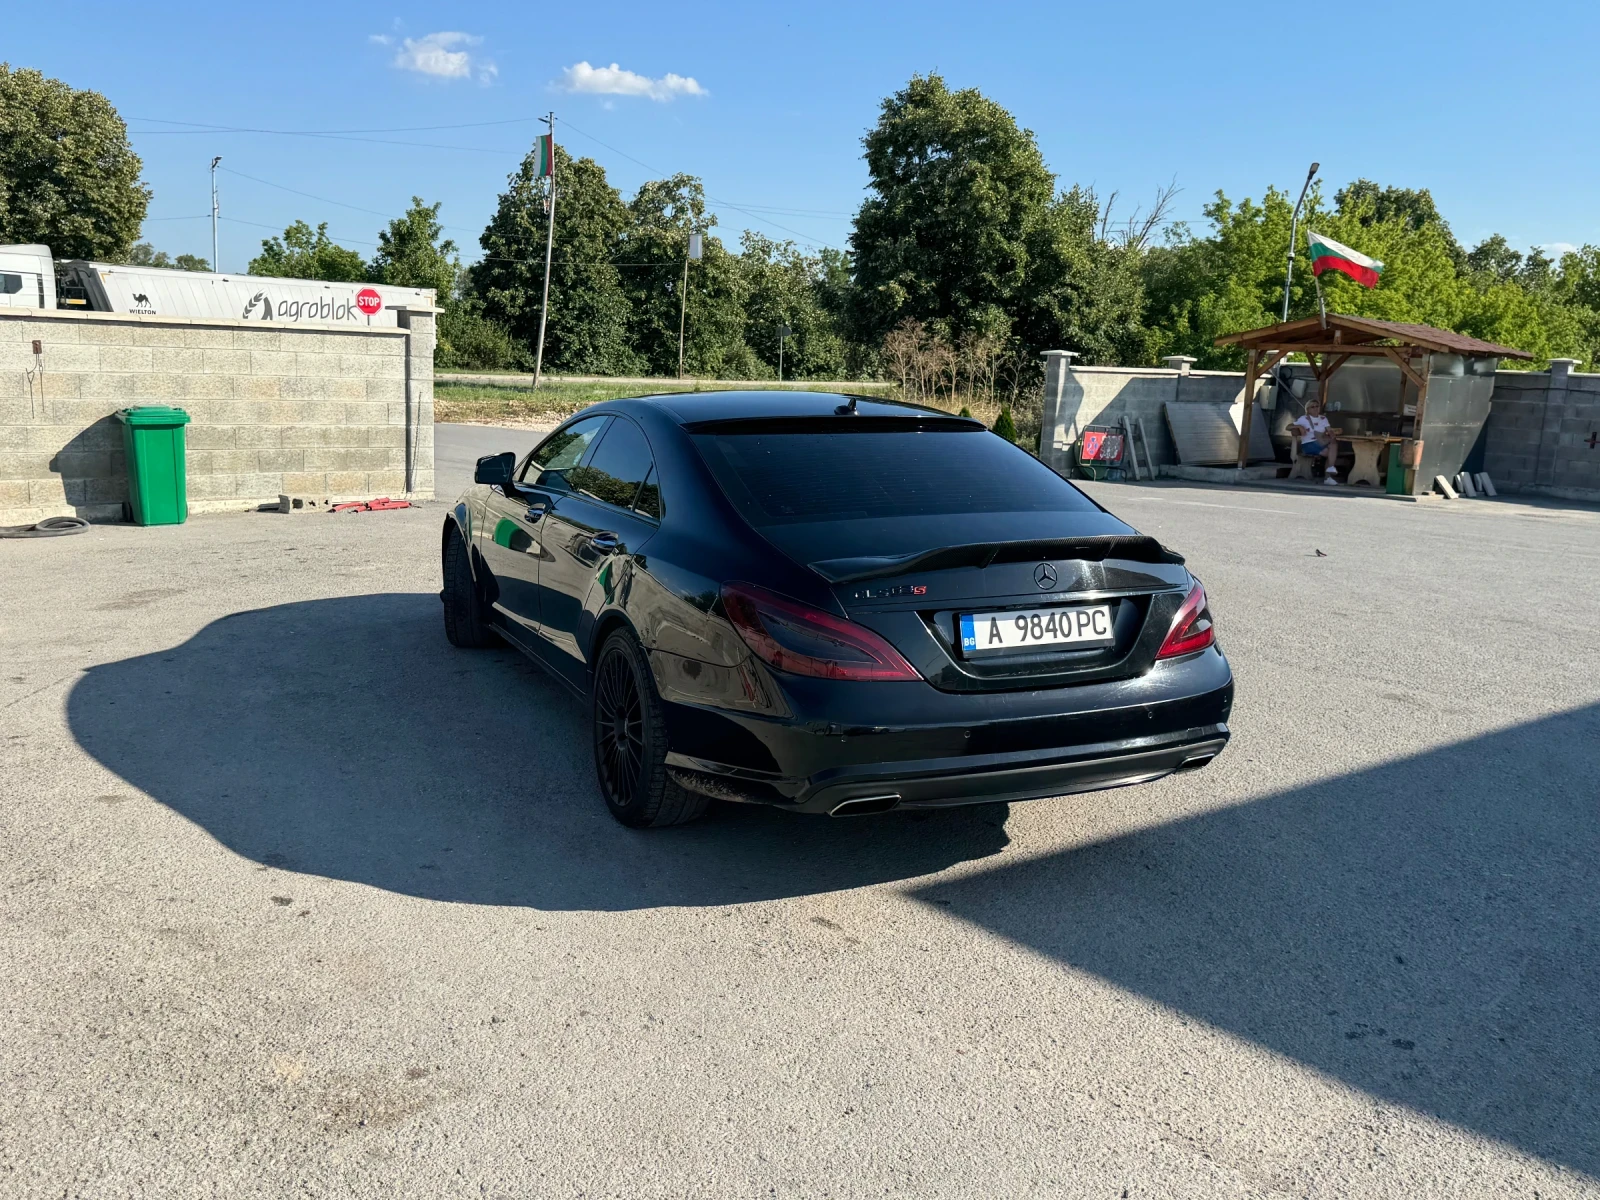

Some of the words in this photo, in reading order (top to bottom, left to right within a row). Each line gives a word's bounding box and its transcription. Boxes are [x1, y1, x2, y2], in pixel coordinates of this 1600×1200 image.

[278, 296, 358, 322] agroblok
[358, 296, 380, 307] STOP
[988, 616, 1003, 644] A
[1014, 611, 1072, 642] 9840
[1076, 609, 1107, 637] PC
[963, 637, 976, 647] BG
